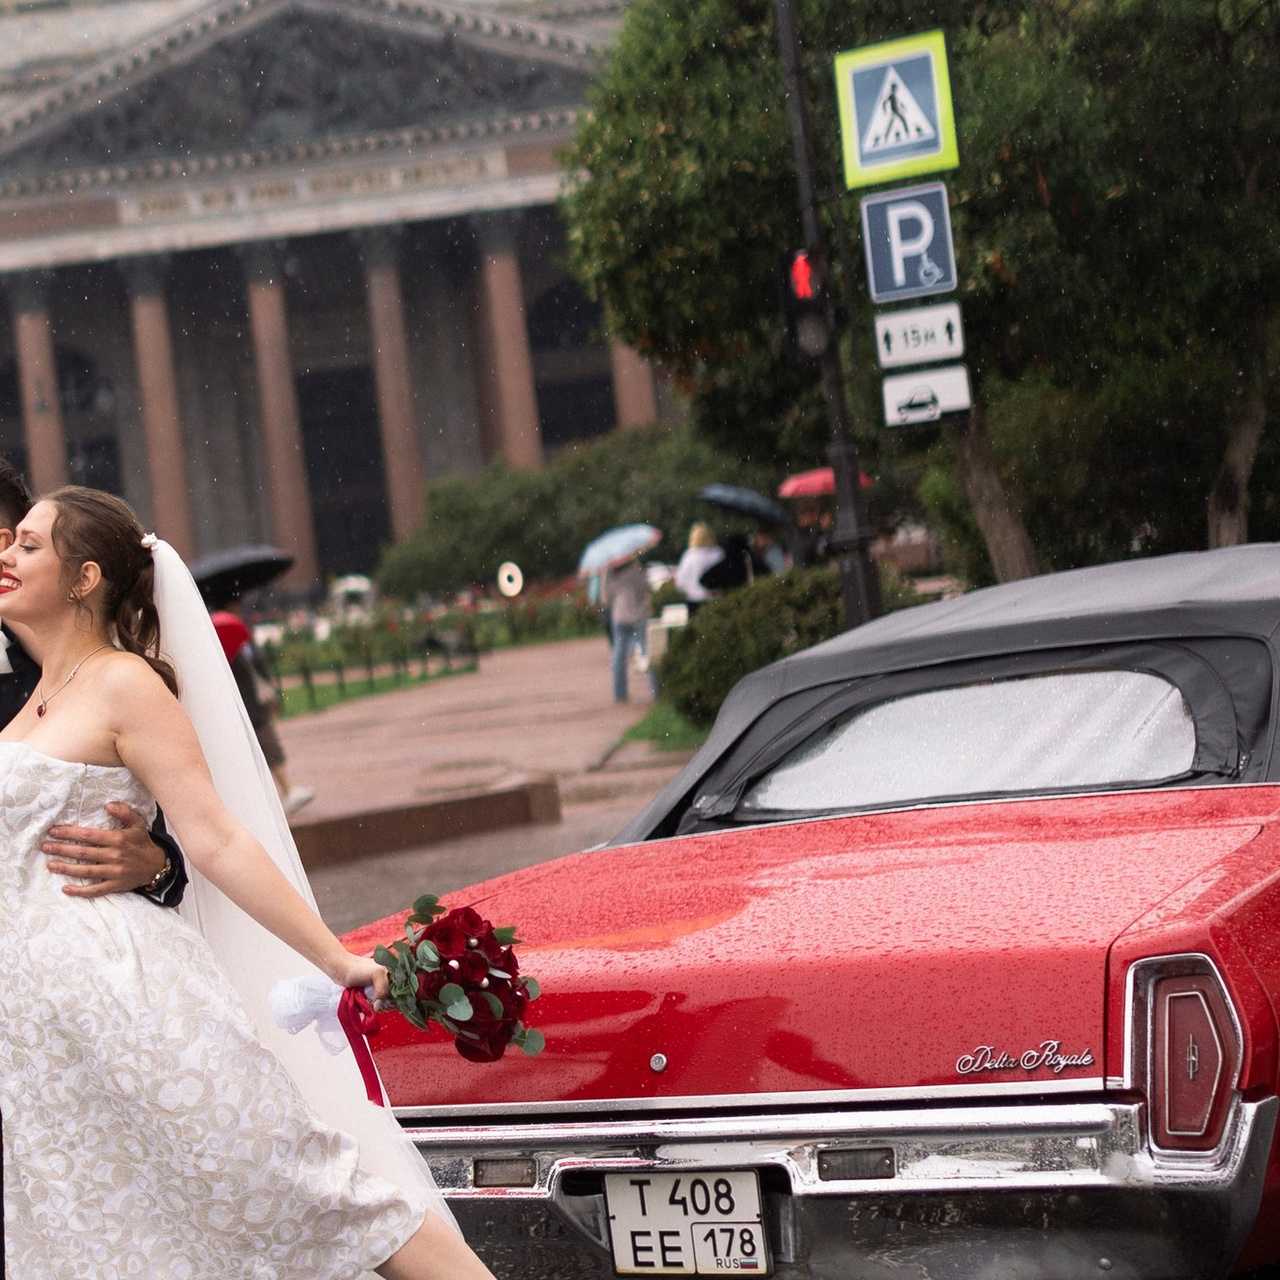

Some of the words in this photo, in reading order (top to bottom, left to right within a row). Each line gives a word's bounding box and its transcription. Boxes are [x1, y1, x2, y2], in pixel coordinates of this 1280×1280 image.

[956, 1045, 1019, 1074] Delta
[1020, 1040, 1093, 1073] Royale
[668, 1178, 735, 1216] 408
[703, 1228, 756, 1257] 178
[716, 1258, 740, 1269] RUS
